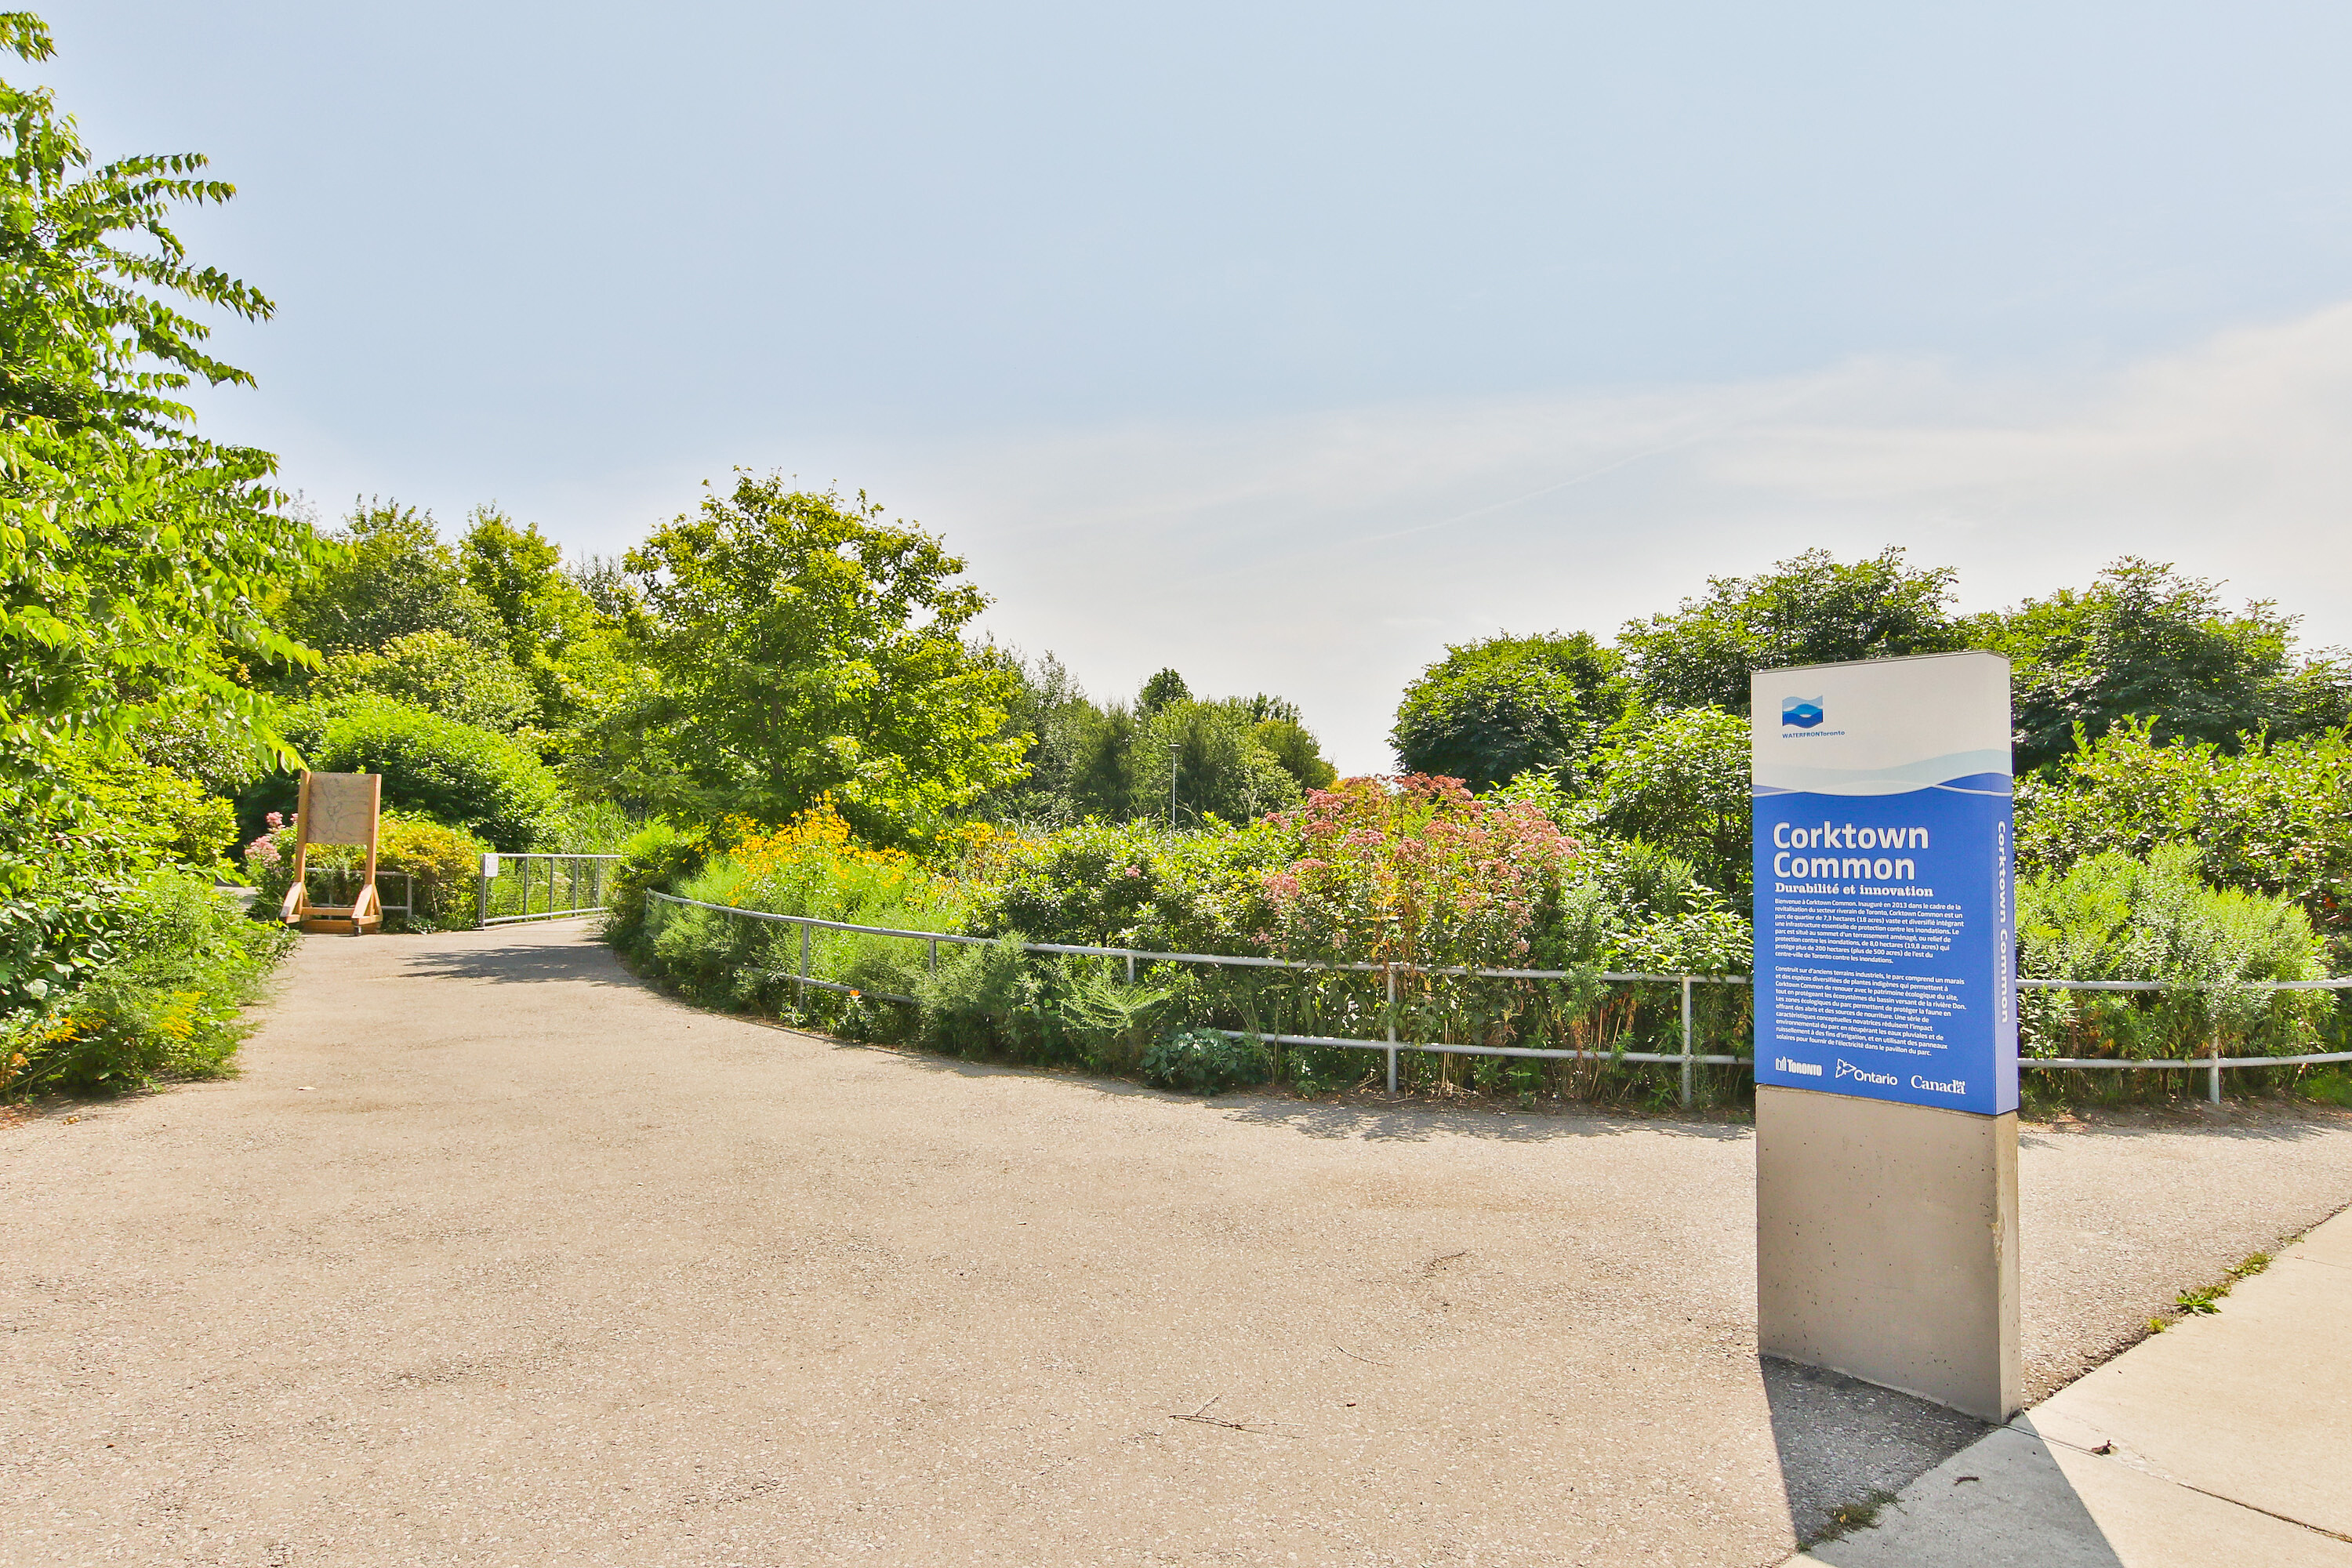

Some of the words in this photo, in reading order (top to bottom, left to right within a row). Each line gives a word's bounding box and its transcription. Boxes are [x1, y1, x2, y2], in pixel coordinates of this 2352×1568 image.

[1773, 820, 1929, 849] Corktown
[1773, 851, 1915, 880] Common
[1998, 820, 2007, 924] Corktown
[1774, 882, 1839, 894] Durabilité
[1842, 884, 1857, 895] et
[1859, 884, 1934, 897] innovation
[1905, 991, 1936, 999] écologique
[1787, 1059, 1823, 1076] TORONTO
[1853, 1069, 1898, 1086] Ontario
[1911, 1075, 1966, 1094] Canada
